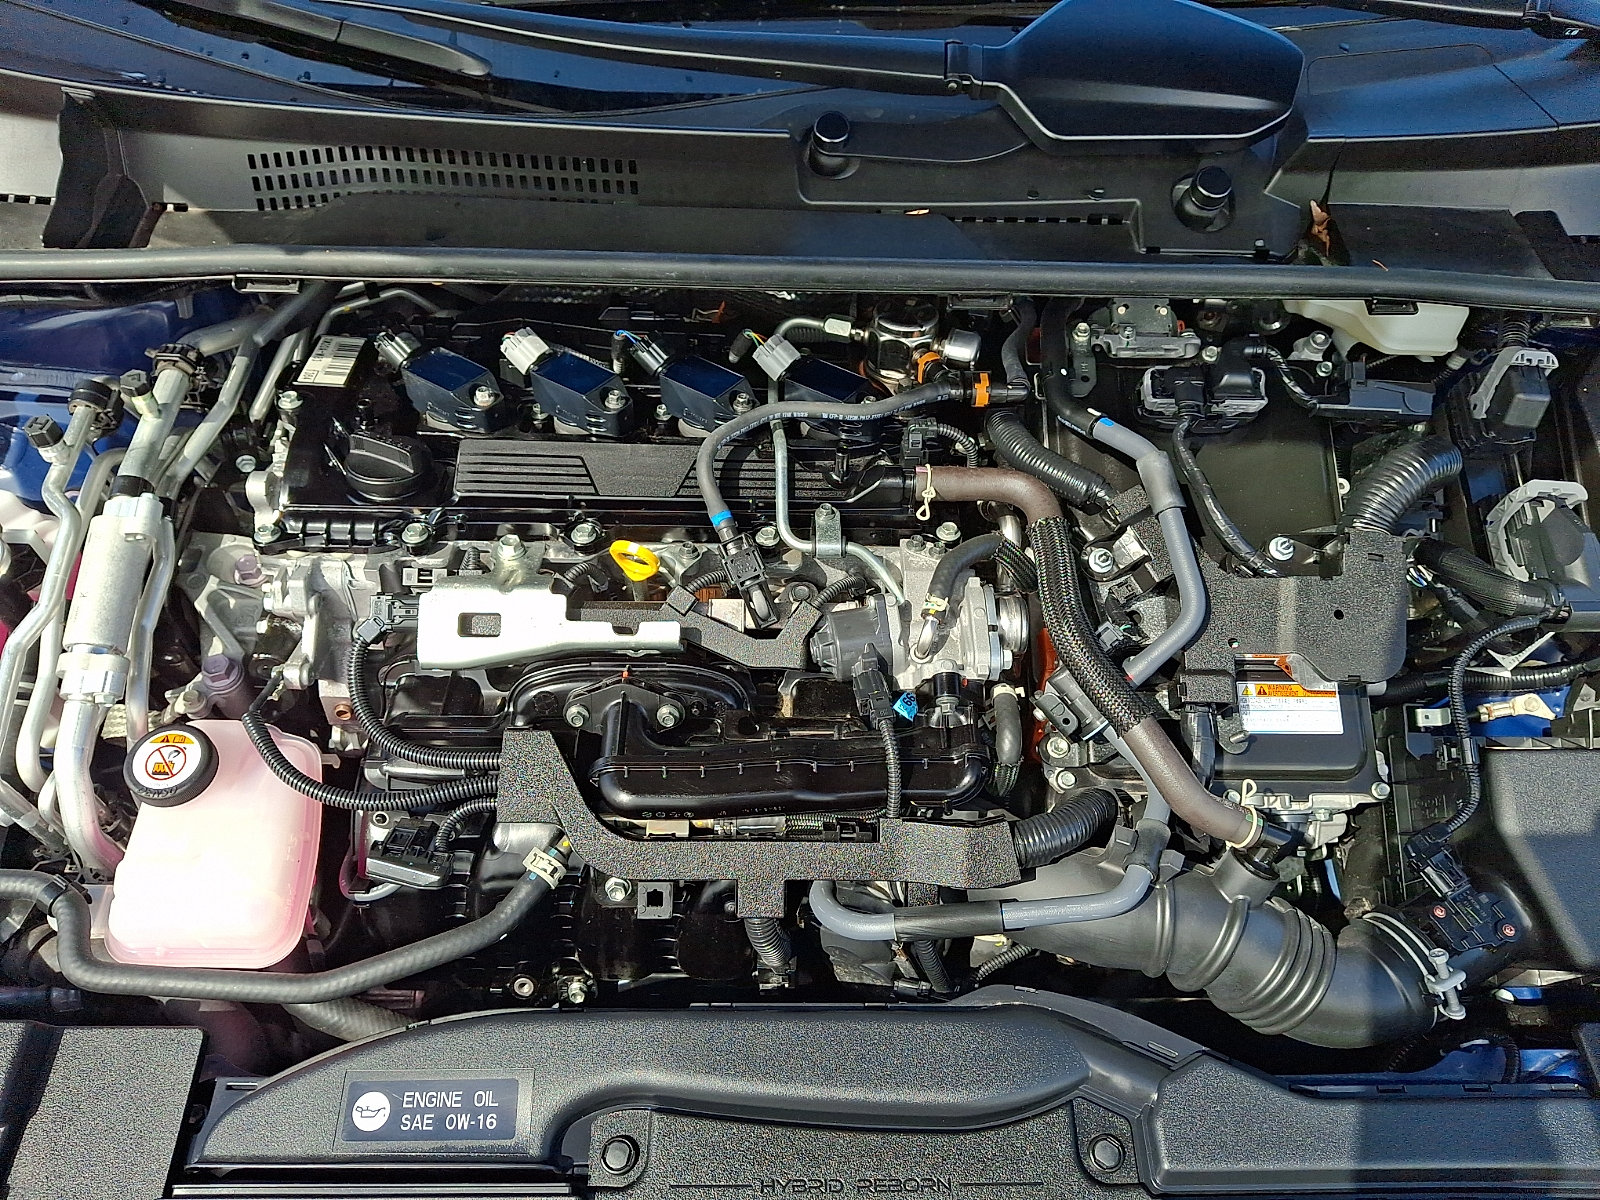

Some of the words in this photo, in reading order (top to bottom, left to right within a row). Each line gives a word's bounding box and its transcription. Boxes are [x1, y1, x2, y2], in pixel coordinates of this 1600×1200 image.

[402, 1091, 463, 1108] ENGINE
[473, 1090, 499, 1107] OIL
[400, 1114, 435, 1131] SAE
[445, 1113, 497, 1130] 0W-16
[760, 1177, 844, 1194] HYBRID
[856, 1177, 951, 1193] REBORN
